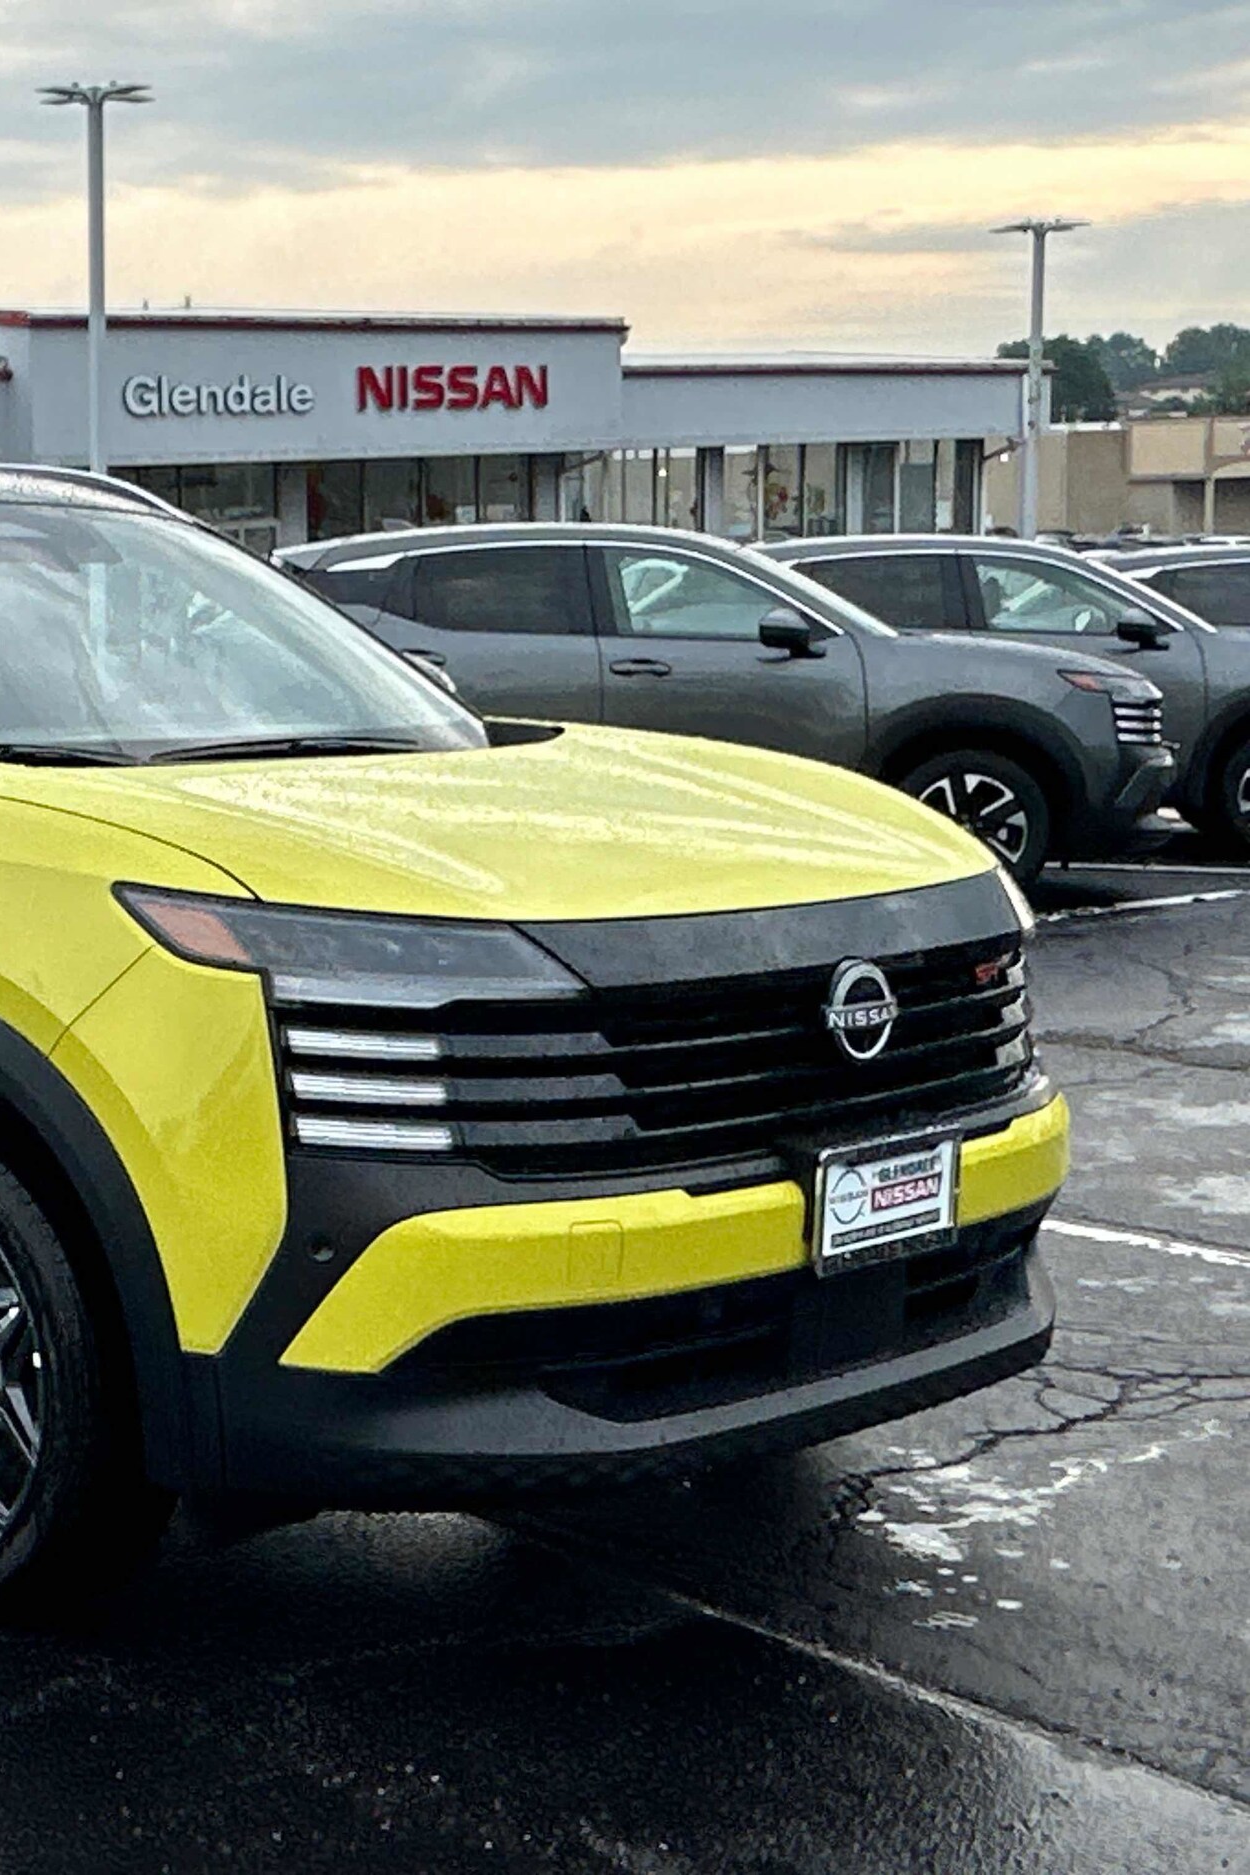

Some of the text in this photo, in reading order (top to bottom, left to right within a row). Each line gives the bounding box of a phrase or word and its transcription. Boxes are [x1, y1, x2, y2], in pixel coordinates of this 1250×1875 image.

[123, 365, 548, 417] Glendale NISSAN
[873, 1177, 939, 1209] NISSAN
